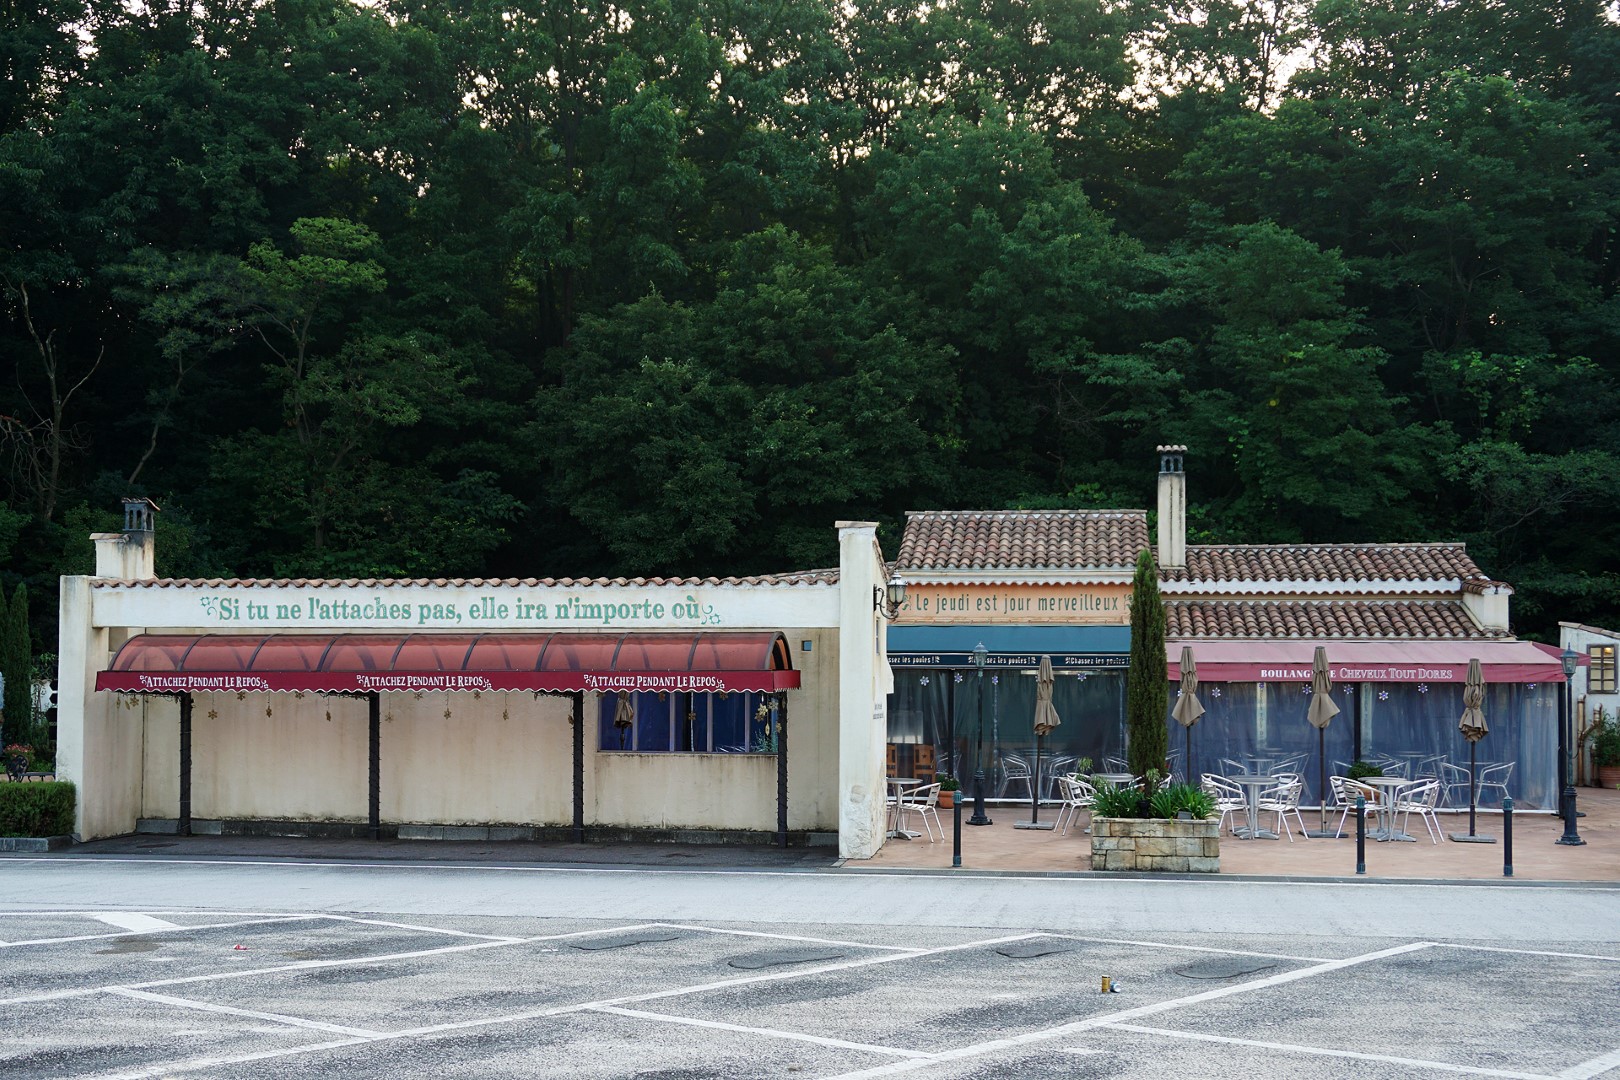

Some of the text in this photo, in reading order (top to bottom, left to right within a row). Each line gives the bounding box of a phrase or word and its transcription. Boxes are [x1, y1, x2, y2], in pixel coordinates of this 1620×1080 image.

[219, 594, 700, 625] Si tu ne l'attaches pas, elle ira n'importe où
[916, 593, 1118, 614] Le jeudi est jour merveilleux
[888, 656, 901, 664] ssez
[1071, 656, 1094, 665] Chassez
[1261, 667, 1453, 679] BOULANGE CHEVEUX TOUT DORES
[146, 676, 260, 688] ATTACHEZ PENDANT LE REPOS
[363, 675, 483, 687] ATTACHEZ PENDANT LE REPOS
[591, 675, 716, 687] ATTACHEZ PENDANT LE REPOS
